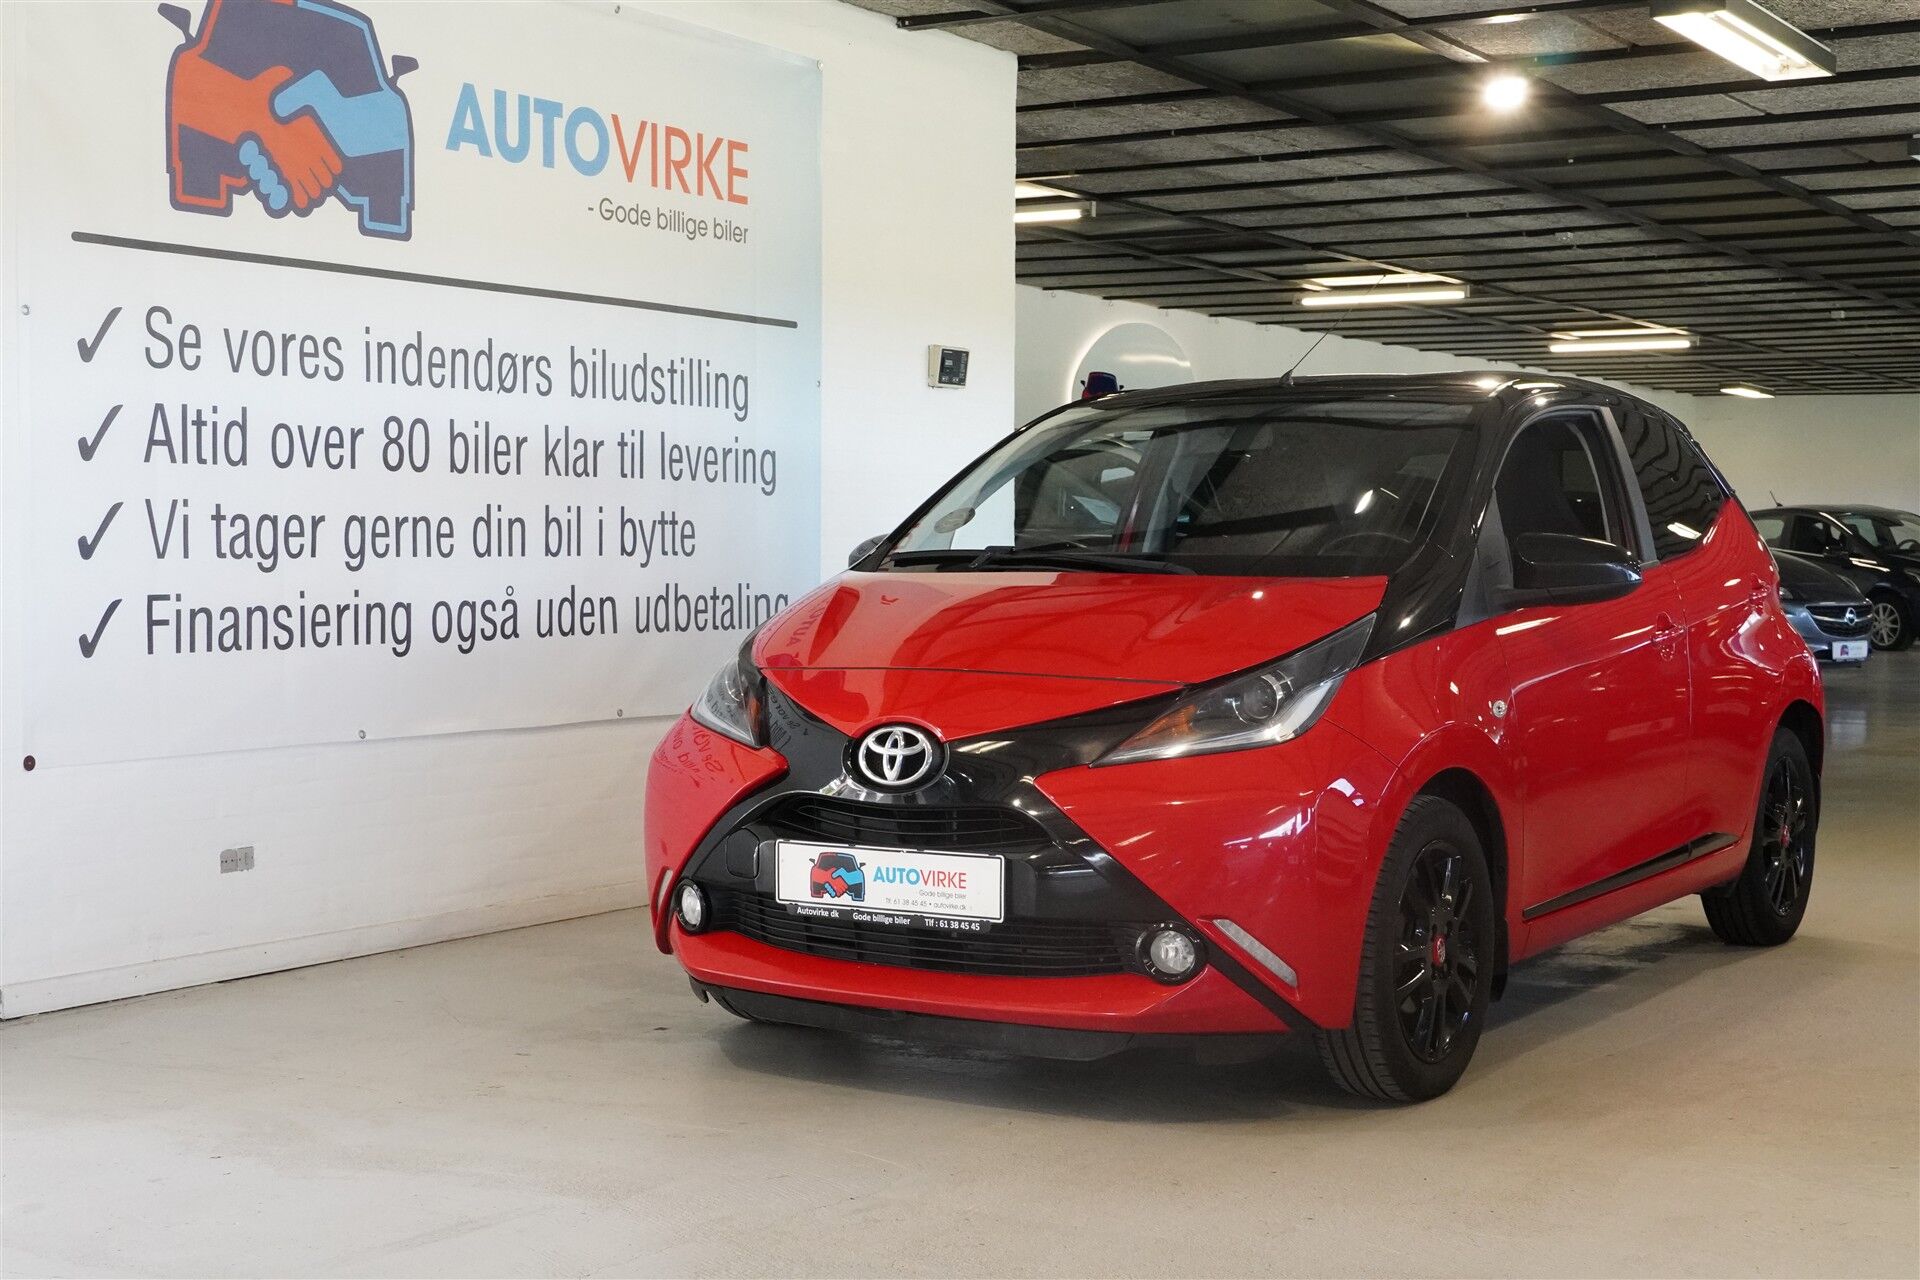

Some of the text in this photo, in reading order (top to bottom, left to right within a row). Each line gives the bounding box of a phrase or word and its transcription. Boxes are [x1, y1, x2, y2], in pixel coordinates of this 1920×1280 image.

[446, 83, 749, 207] AUTOVIRKE
[599, 198, 651, 228] Gode
[657, 206, 709, 242] billige
[714, 217, 749, 244] biler
[145, 305, 749, 423] Se vores indendørs biludstilling
[144, 403, 777, 497] Altid over 80 biler klar til levering
[145, 498, 696, 574] Vi tager gerne din bil i bytte
[147, 589, 412, 658] Finansiering
[432, 585, 520, 655] også
[537, 584, 618, 639] uden
[873, 866, 967, 889] AUTOVIRKE
[797, 906, 829, 917] Autovirke
[852, 912, 911, 925] Gode billige biler
[939, 919, 949, 928] 61
[949, 920, 959, 929] 38
[960, 921, 969, 930] 45
[970, 922, 980, 931] 45
